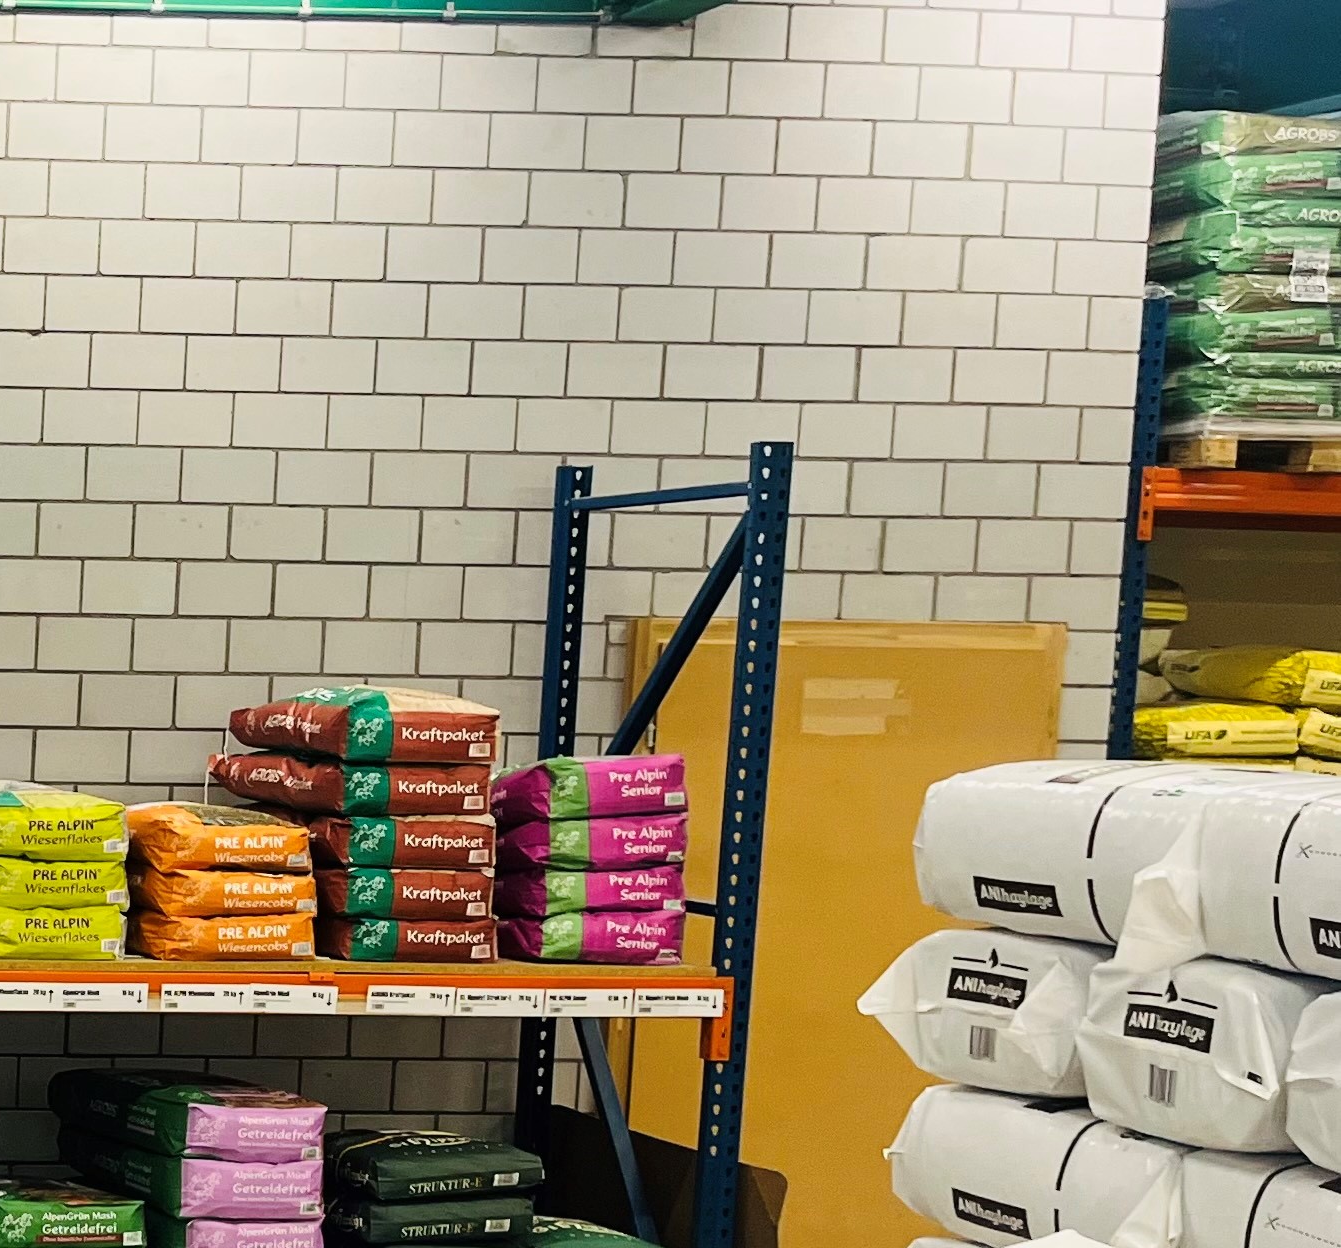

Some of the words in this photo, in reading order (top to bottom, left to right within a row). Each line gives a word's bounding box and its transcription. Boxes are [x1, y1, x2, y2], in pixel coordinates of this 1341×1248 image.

[401, 728, 485, 743] Kraftpaket
[1185, 730, 1212, 741] UFA
[609, 771, 632, 783] Pre
[635, 769, 667, 783] Alpin
[398, 780, 479, 796] Kraftpaket
[621, 784, 662, 797] Senior
[28, 819, 53, 831] PRE
[21, 832, 102, 845] Wiesenflakes
[612, 827, 636, 840] Pre
[638, 827, 672, 841] Alpin
[215, 837, 240, 848] PRE
[404, 834, 484, 849] Kraftpaket
[624, 841, 666, 855] Senior
[214, 851, 288, 863] Wiesencobs
[33, 869, 57, 880] PRE
[25, 881, 106, 895] Wiesenflakes
[224, 882, 249, 894] PRE
[402, 887, 481, 902] Kraftpaket
[620, 888, 662, 901] Senior
[223, 897, 297, 909] Wiesencobs
[25, 918, 49, 929] PRE
[18, 932, 99, 944] Wiesenflakes
[218, 927, 243, 939] PRE
[406, 930, 485, 946] Kraftpaket
[217, 942, 291, 953] Wiesencobs
[616, 937, 659, 950] Senior
[93, 1210, 117, 1220] Mash
[42, 1222, 117, 1235] Getreidefrei
